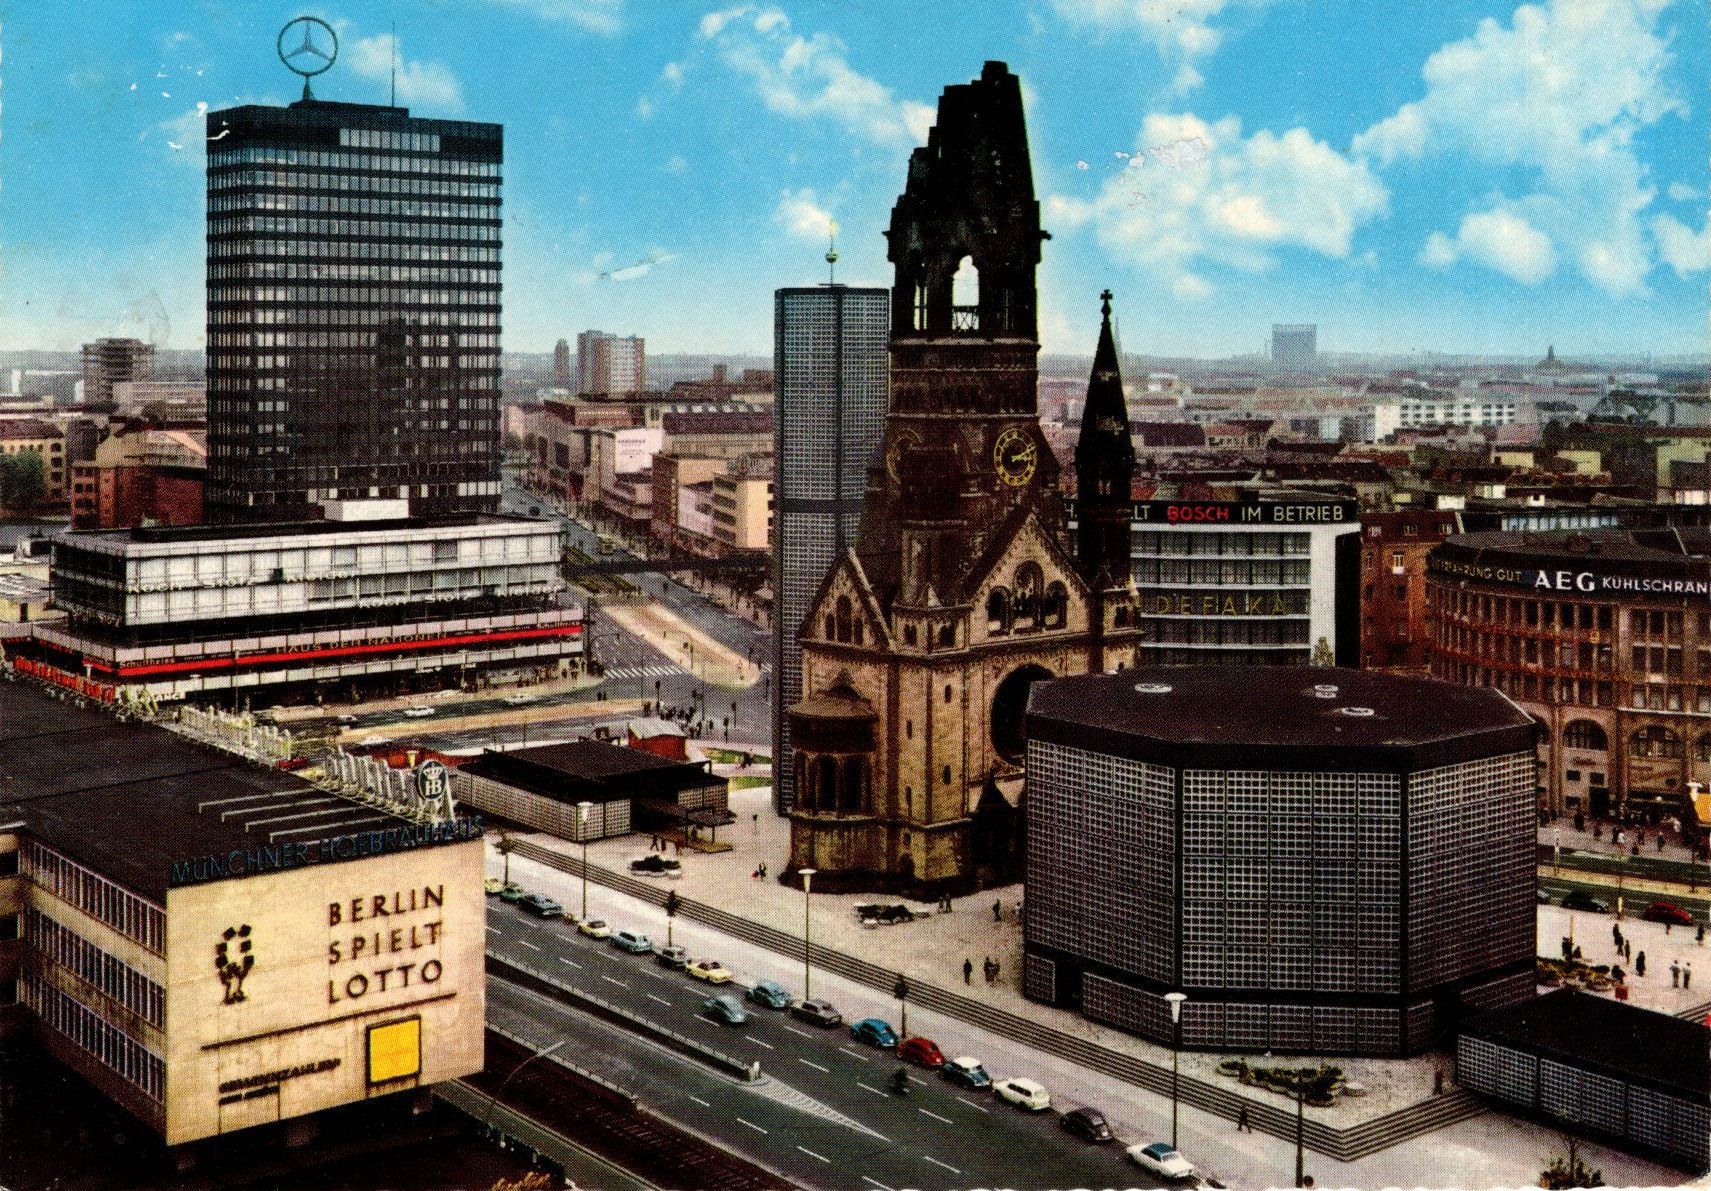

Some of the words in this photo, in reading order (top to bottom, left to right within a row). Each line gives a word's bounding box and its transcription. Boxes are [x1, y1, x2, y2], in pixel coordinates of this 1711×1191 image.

[1166, 505, 1230, 522] BOSCH
[1241, 506, 1262, 521] IM
[1273, 505, 1344, 522] BETRIEB
[1534, 569, 1596, 592] AEG
[1602, 575, 1711, 594] KÜHLSCHRÄN
[329, 885, 443, 927] BERLIN
[329, 921, 442, 966] SPIELT
[329, 959, 442, 1004] LOTTO
